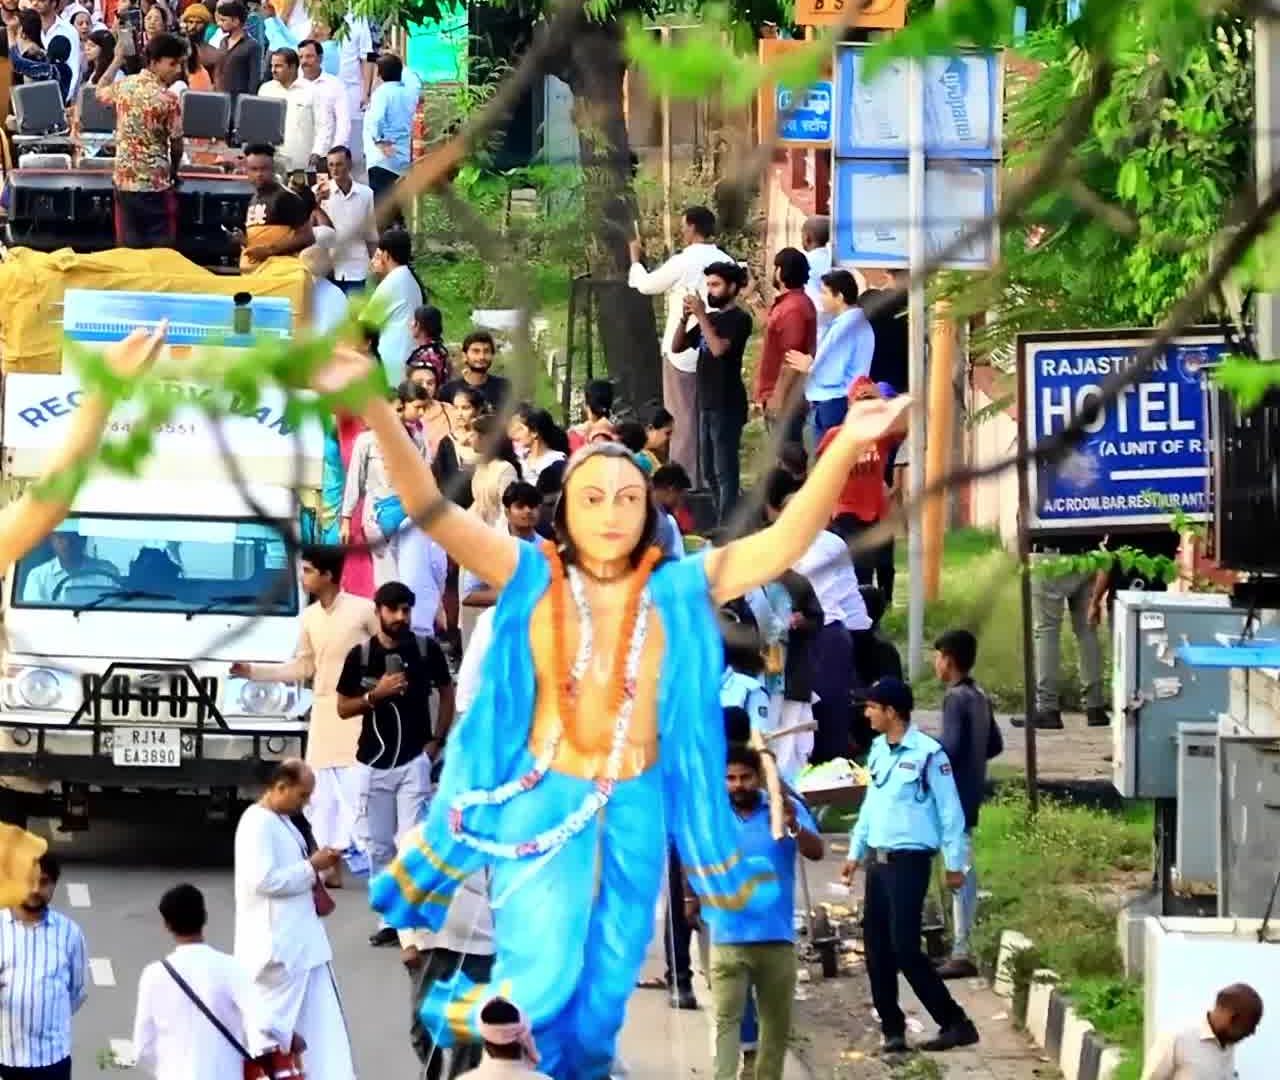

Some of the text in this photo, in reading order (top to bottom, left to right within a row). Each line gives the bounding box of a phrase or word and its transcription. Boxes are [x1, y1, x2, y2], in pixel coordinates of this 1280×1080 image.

[1042, 382, 1196, 436] HOTEL
[1121, 440, 1157, 456] UNIT
[1161, 439, 1184, 454] OF
[132, 730, 166, 745] RJ14
[124, 748, 175, 764] EA3890
